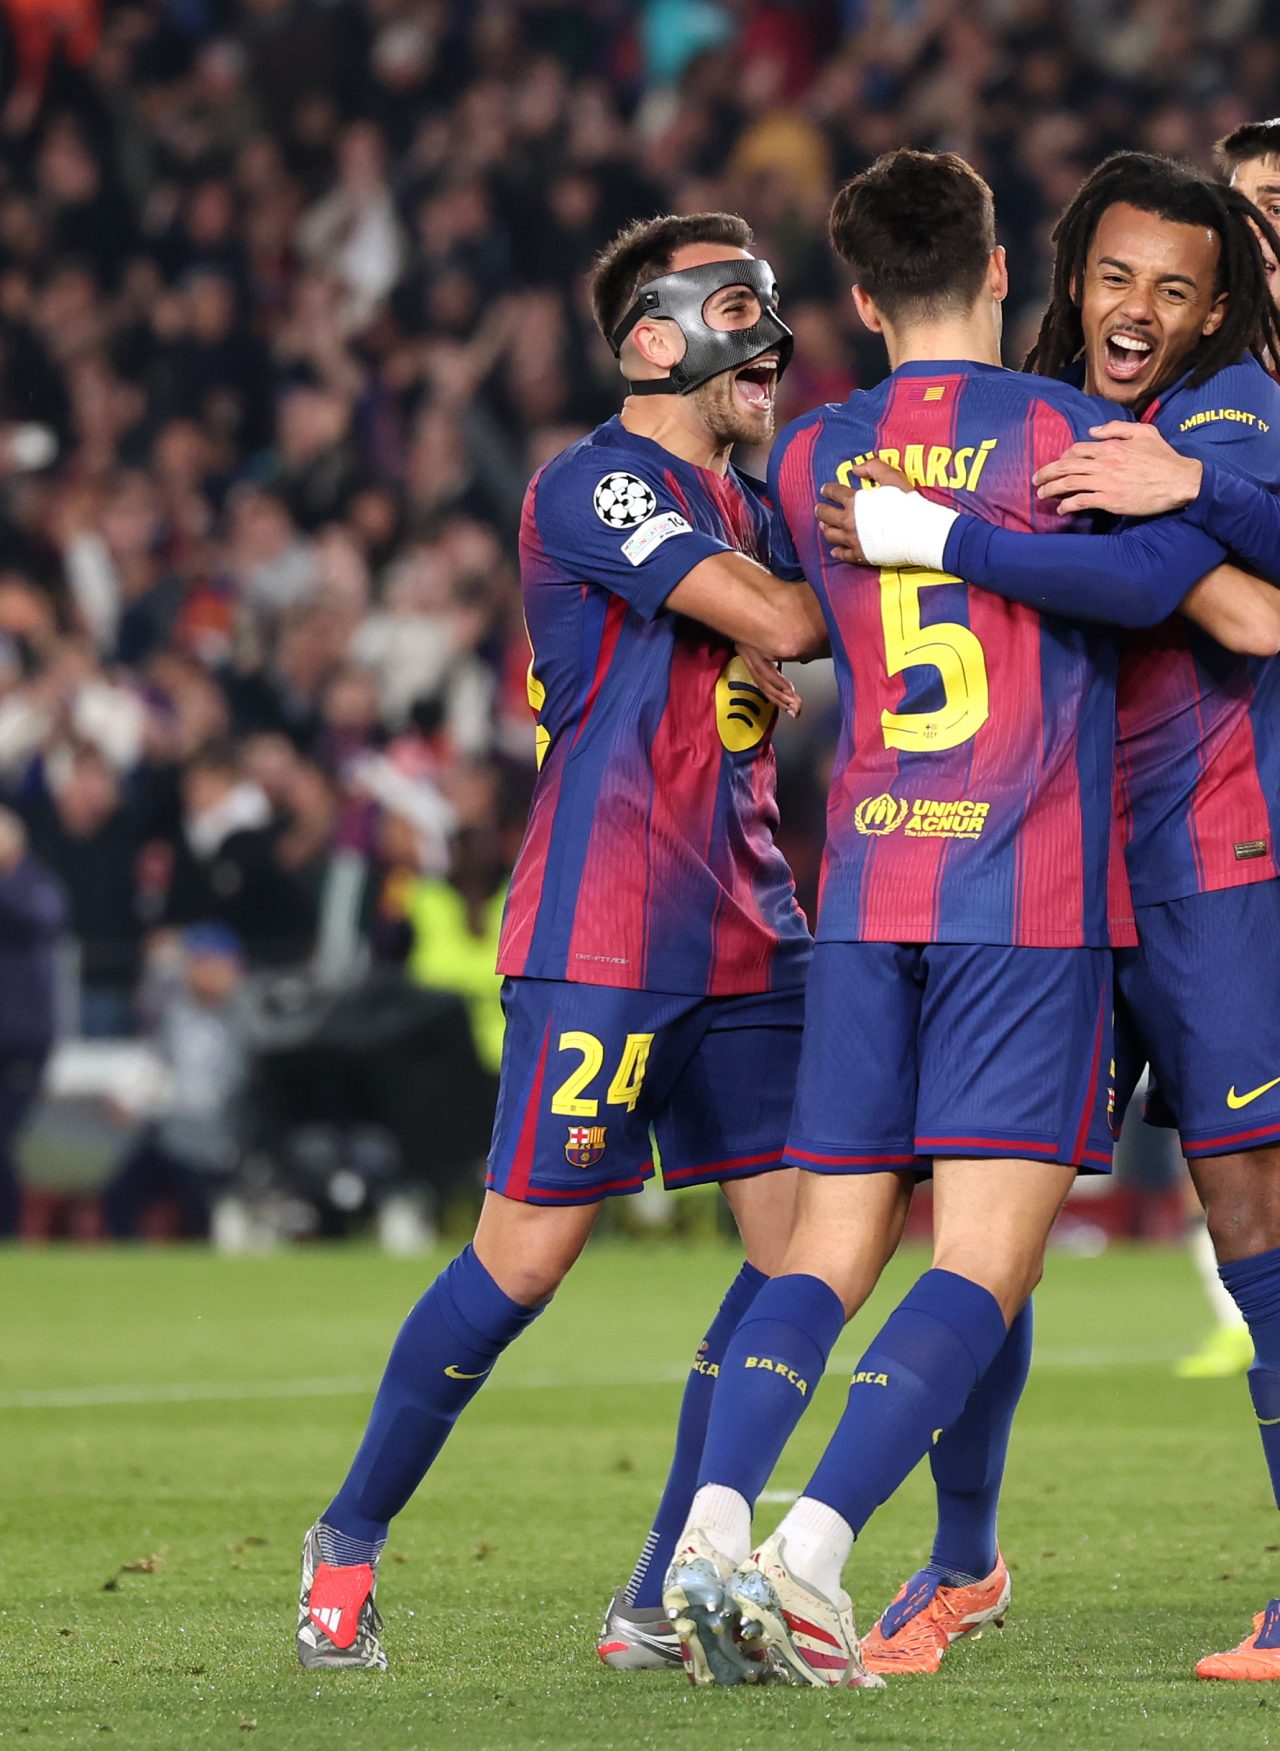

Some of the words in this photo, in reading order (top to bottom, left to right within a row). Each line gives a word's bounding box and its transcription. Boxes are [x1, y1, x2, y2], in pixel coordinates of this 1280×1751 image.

[879, 565, 990, 753] 5
[904, 815, 985, 832] ACNUR
[911, 799, 990, 817] UNHCR
[551, 1030, 655, 1118] 24
